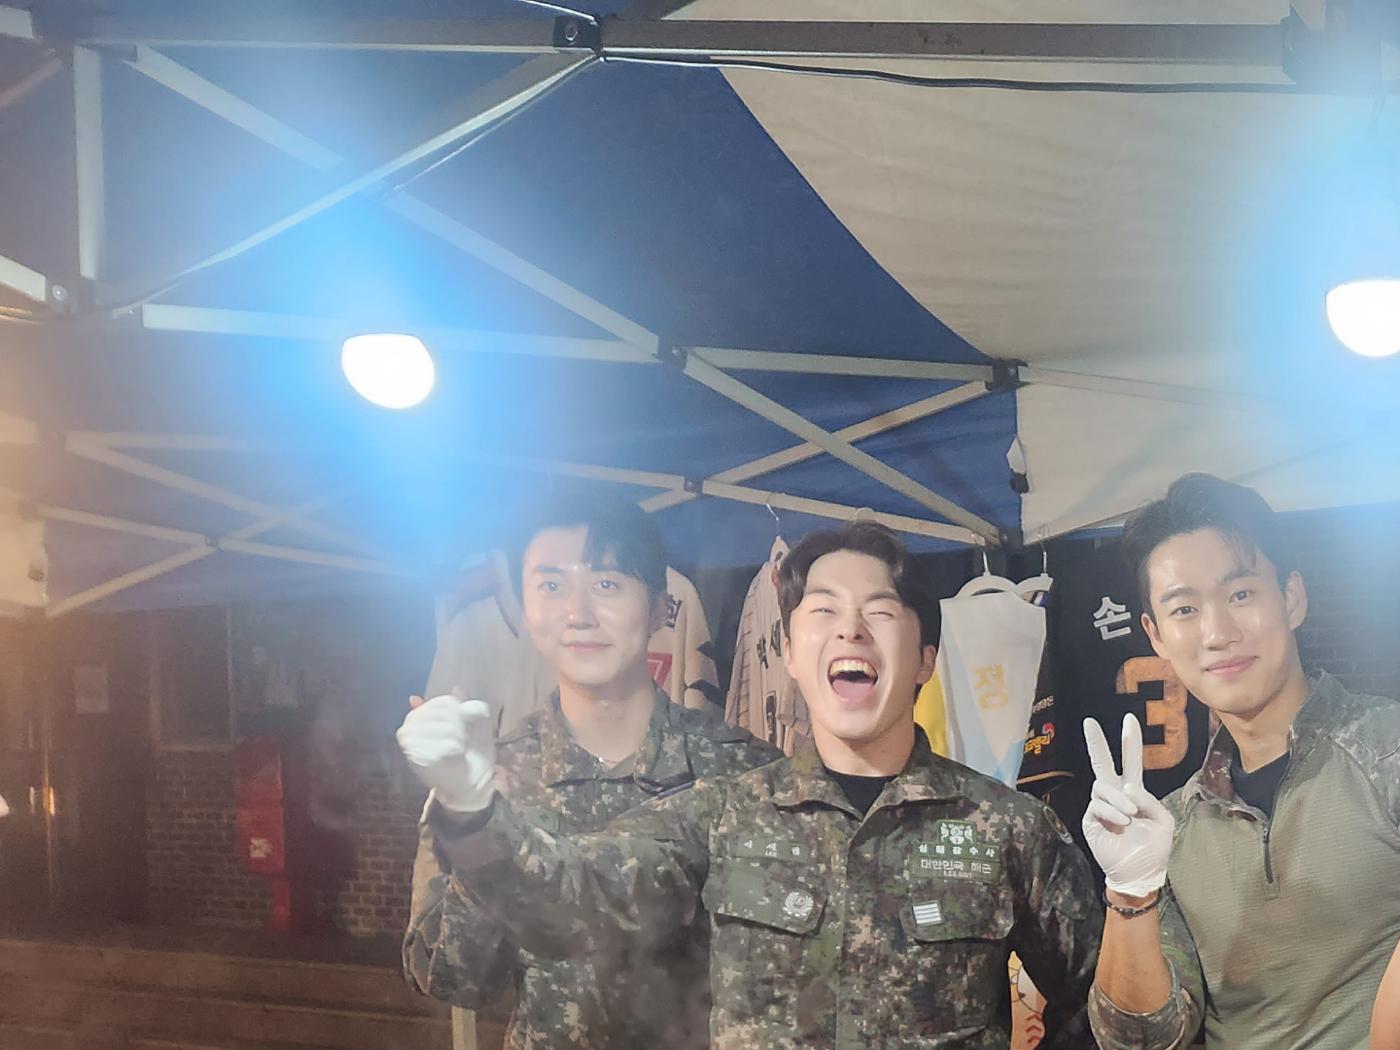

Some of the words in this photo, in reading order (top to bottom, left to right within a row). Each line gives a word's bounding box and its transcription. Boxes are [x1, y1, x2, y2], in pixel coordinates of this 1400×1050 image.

[1093, 596, 1132, 641] 손
[974, 663, 1009, 710] 정
[1115, 656, 1190, 770] 3
[921, 858, 964, 871] 대한민국
[971, 862, 993, 874] 해군
